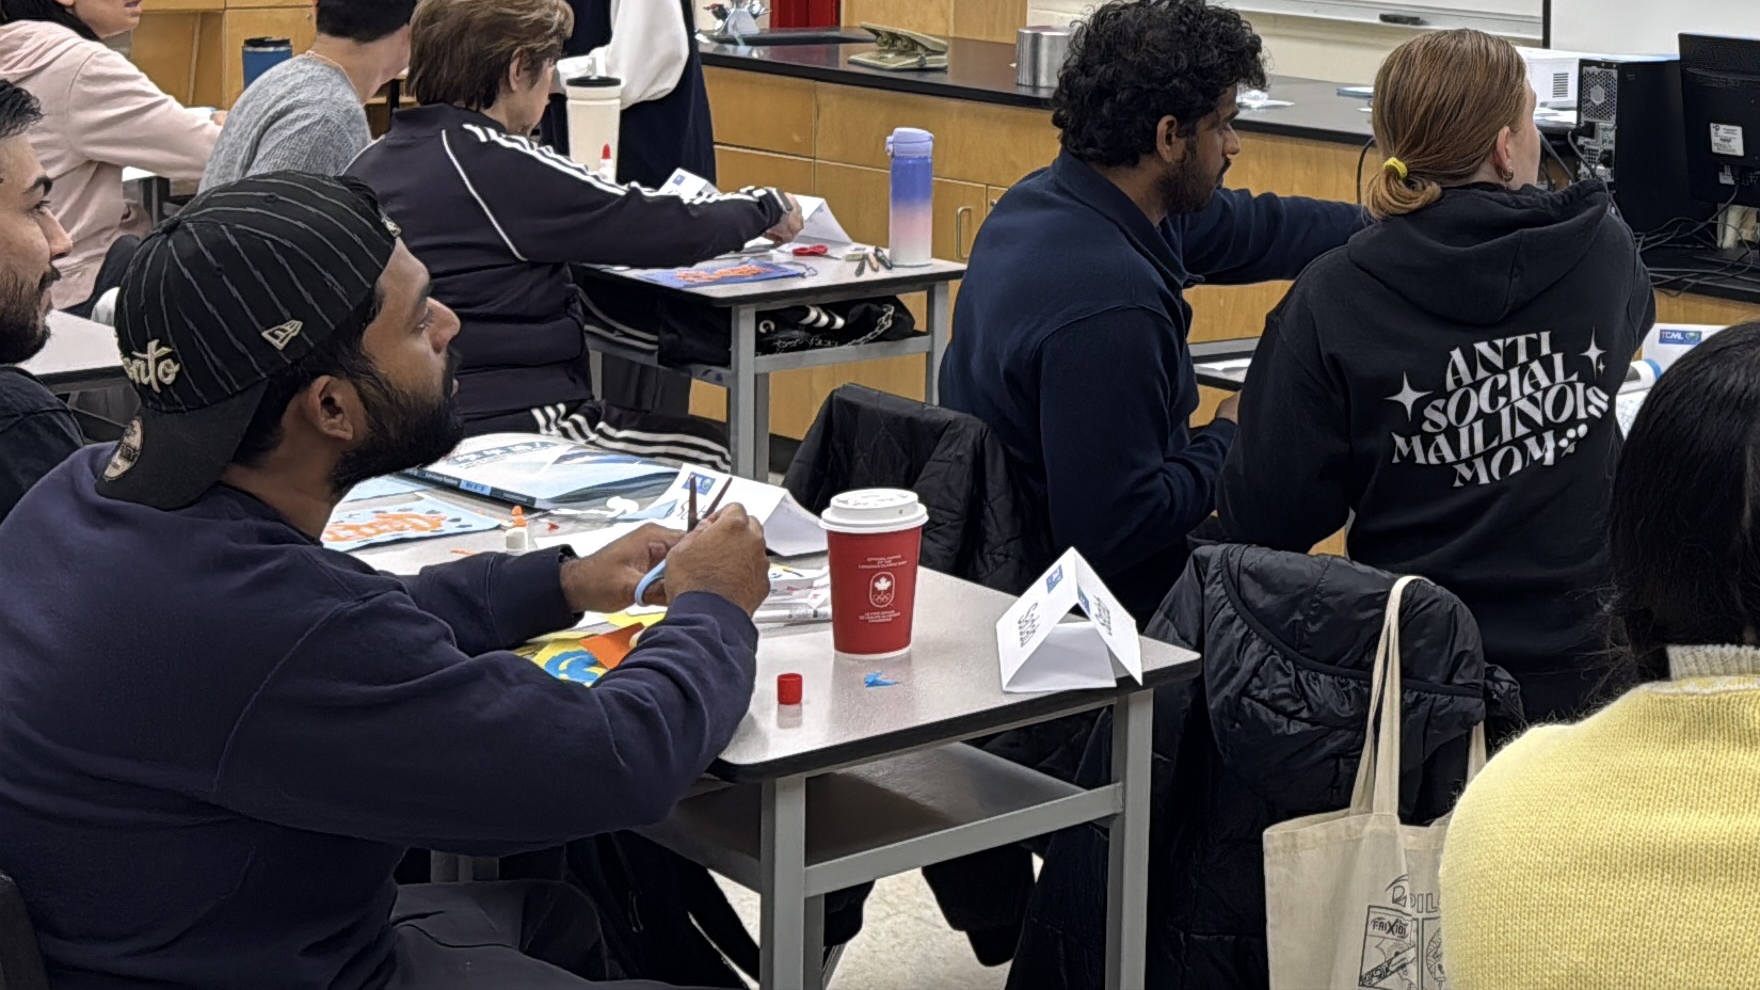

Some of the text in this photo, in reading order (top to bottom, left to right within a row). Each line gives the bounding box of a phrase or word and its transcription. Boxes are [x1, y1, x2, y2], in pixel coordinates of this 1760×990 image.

[1445, 331, 1551, 392] ANTI
[1421, 353, 1579, 433] SOCIAL
[1453, 430, 1555, 488] MOM
